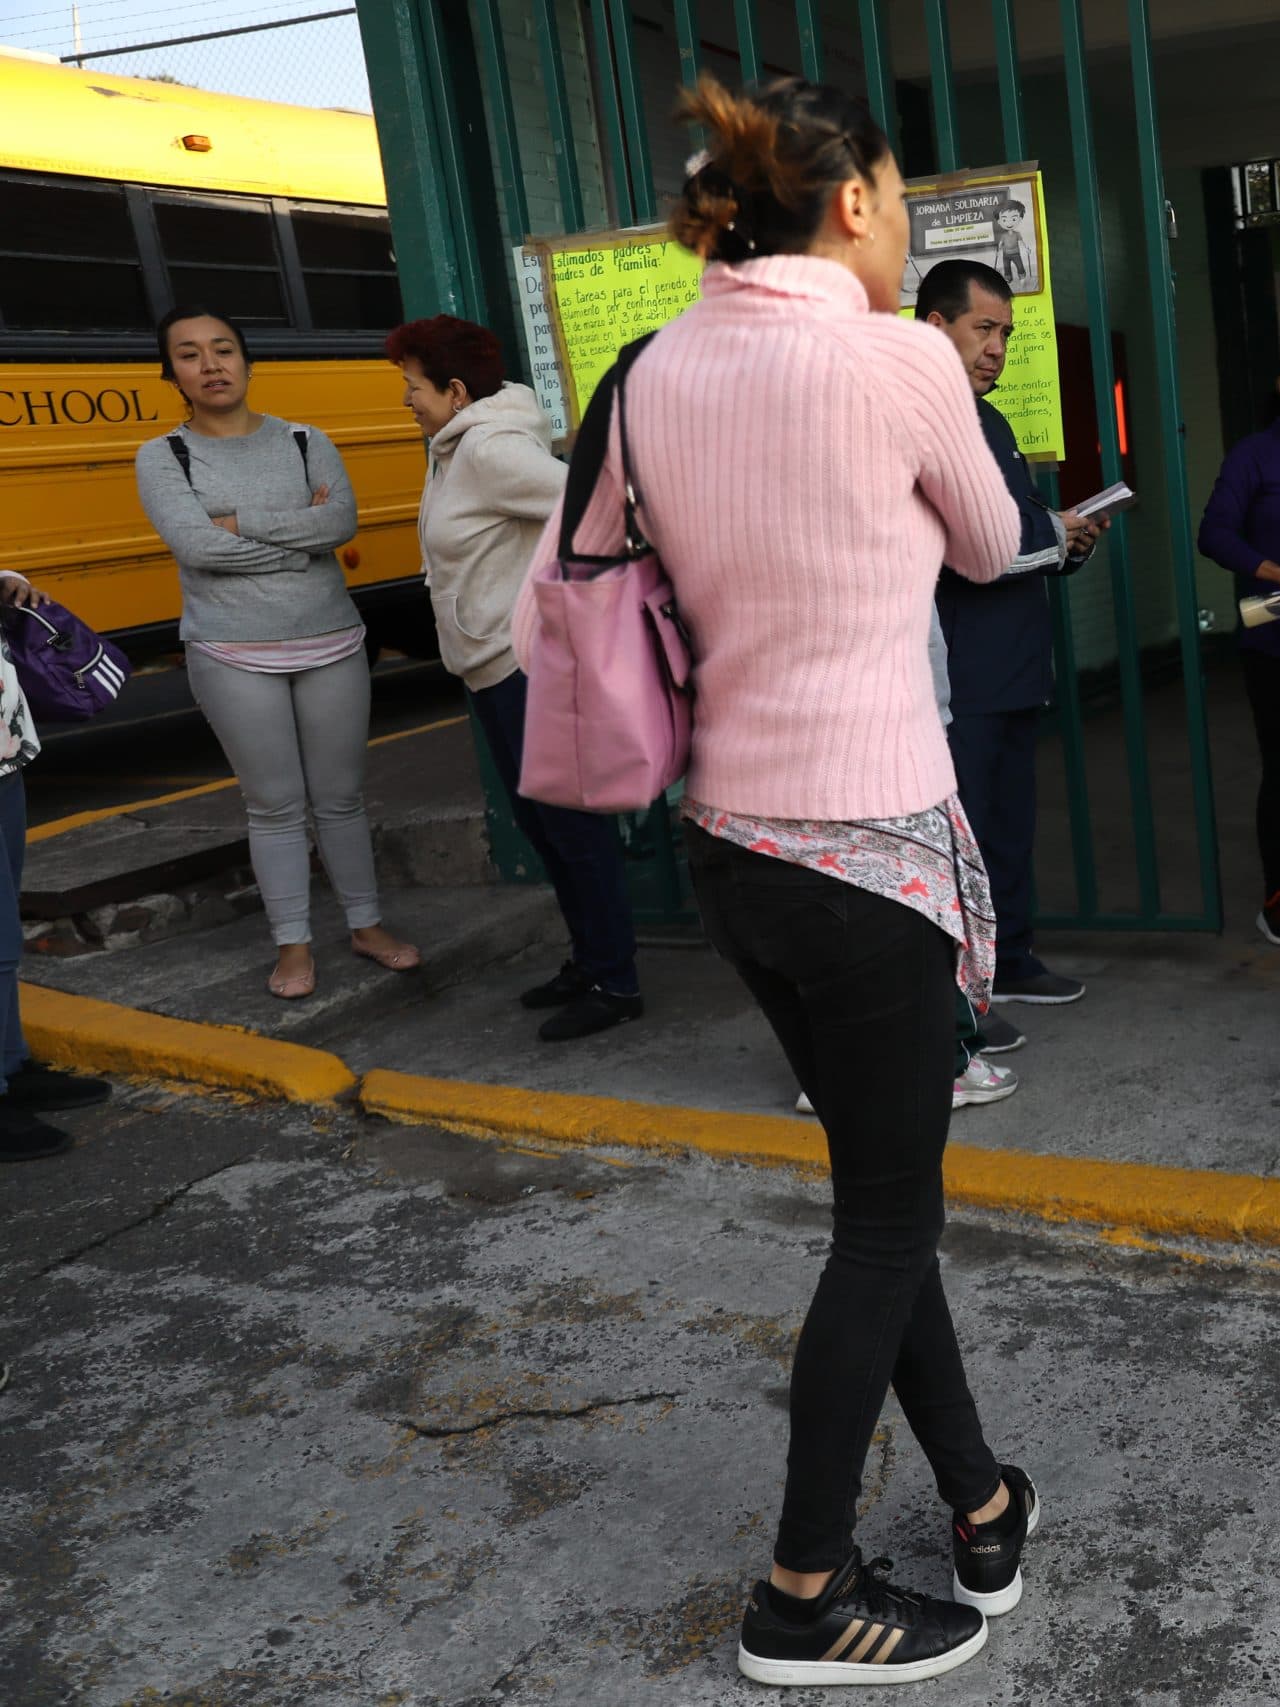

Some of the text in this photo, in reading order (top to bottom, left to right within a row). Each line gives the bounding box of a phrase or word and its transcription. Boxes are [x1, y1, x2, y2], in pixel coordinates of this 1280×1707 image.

[915, 196, 999, 216] JORNADA SOLIDARIA
[931, 211, 984, 227] de LIMPIEZA
[613, 240, 651, 266] padres
[590, 263, 605, 276] de
[618, 254, 661, 273] familia:
[575, 288, 606, 304] tareas
[613, 287, 633, 306] para
[639, 278, 649, 294] el
[621, 311, 631, 324] 3
[633, 308, 644, 322] de
[1023, 305, 1037, 314] un
[535, 345, 548, 356] no
[1023, 344, 1045, 357] para
[1008, 354, 1030, 366] aula
[543, 374, 560, 390] los
[541, 394, 552, 409] la
[1022, 427, 1049, 445] abril
[970, 1544, 1001, 1554] adidas
